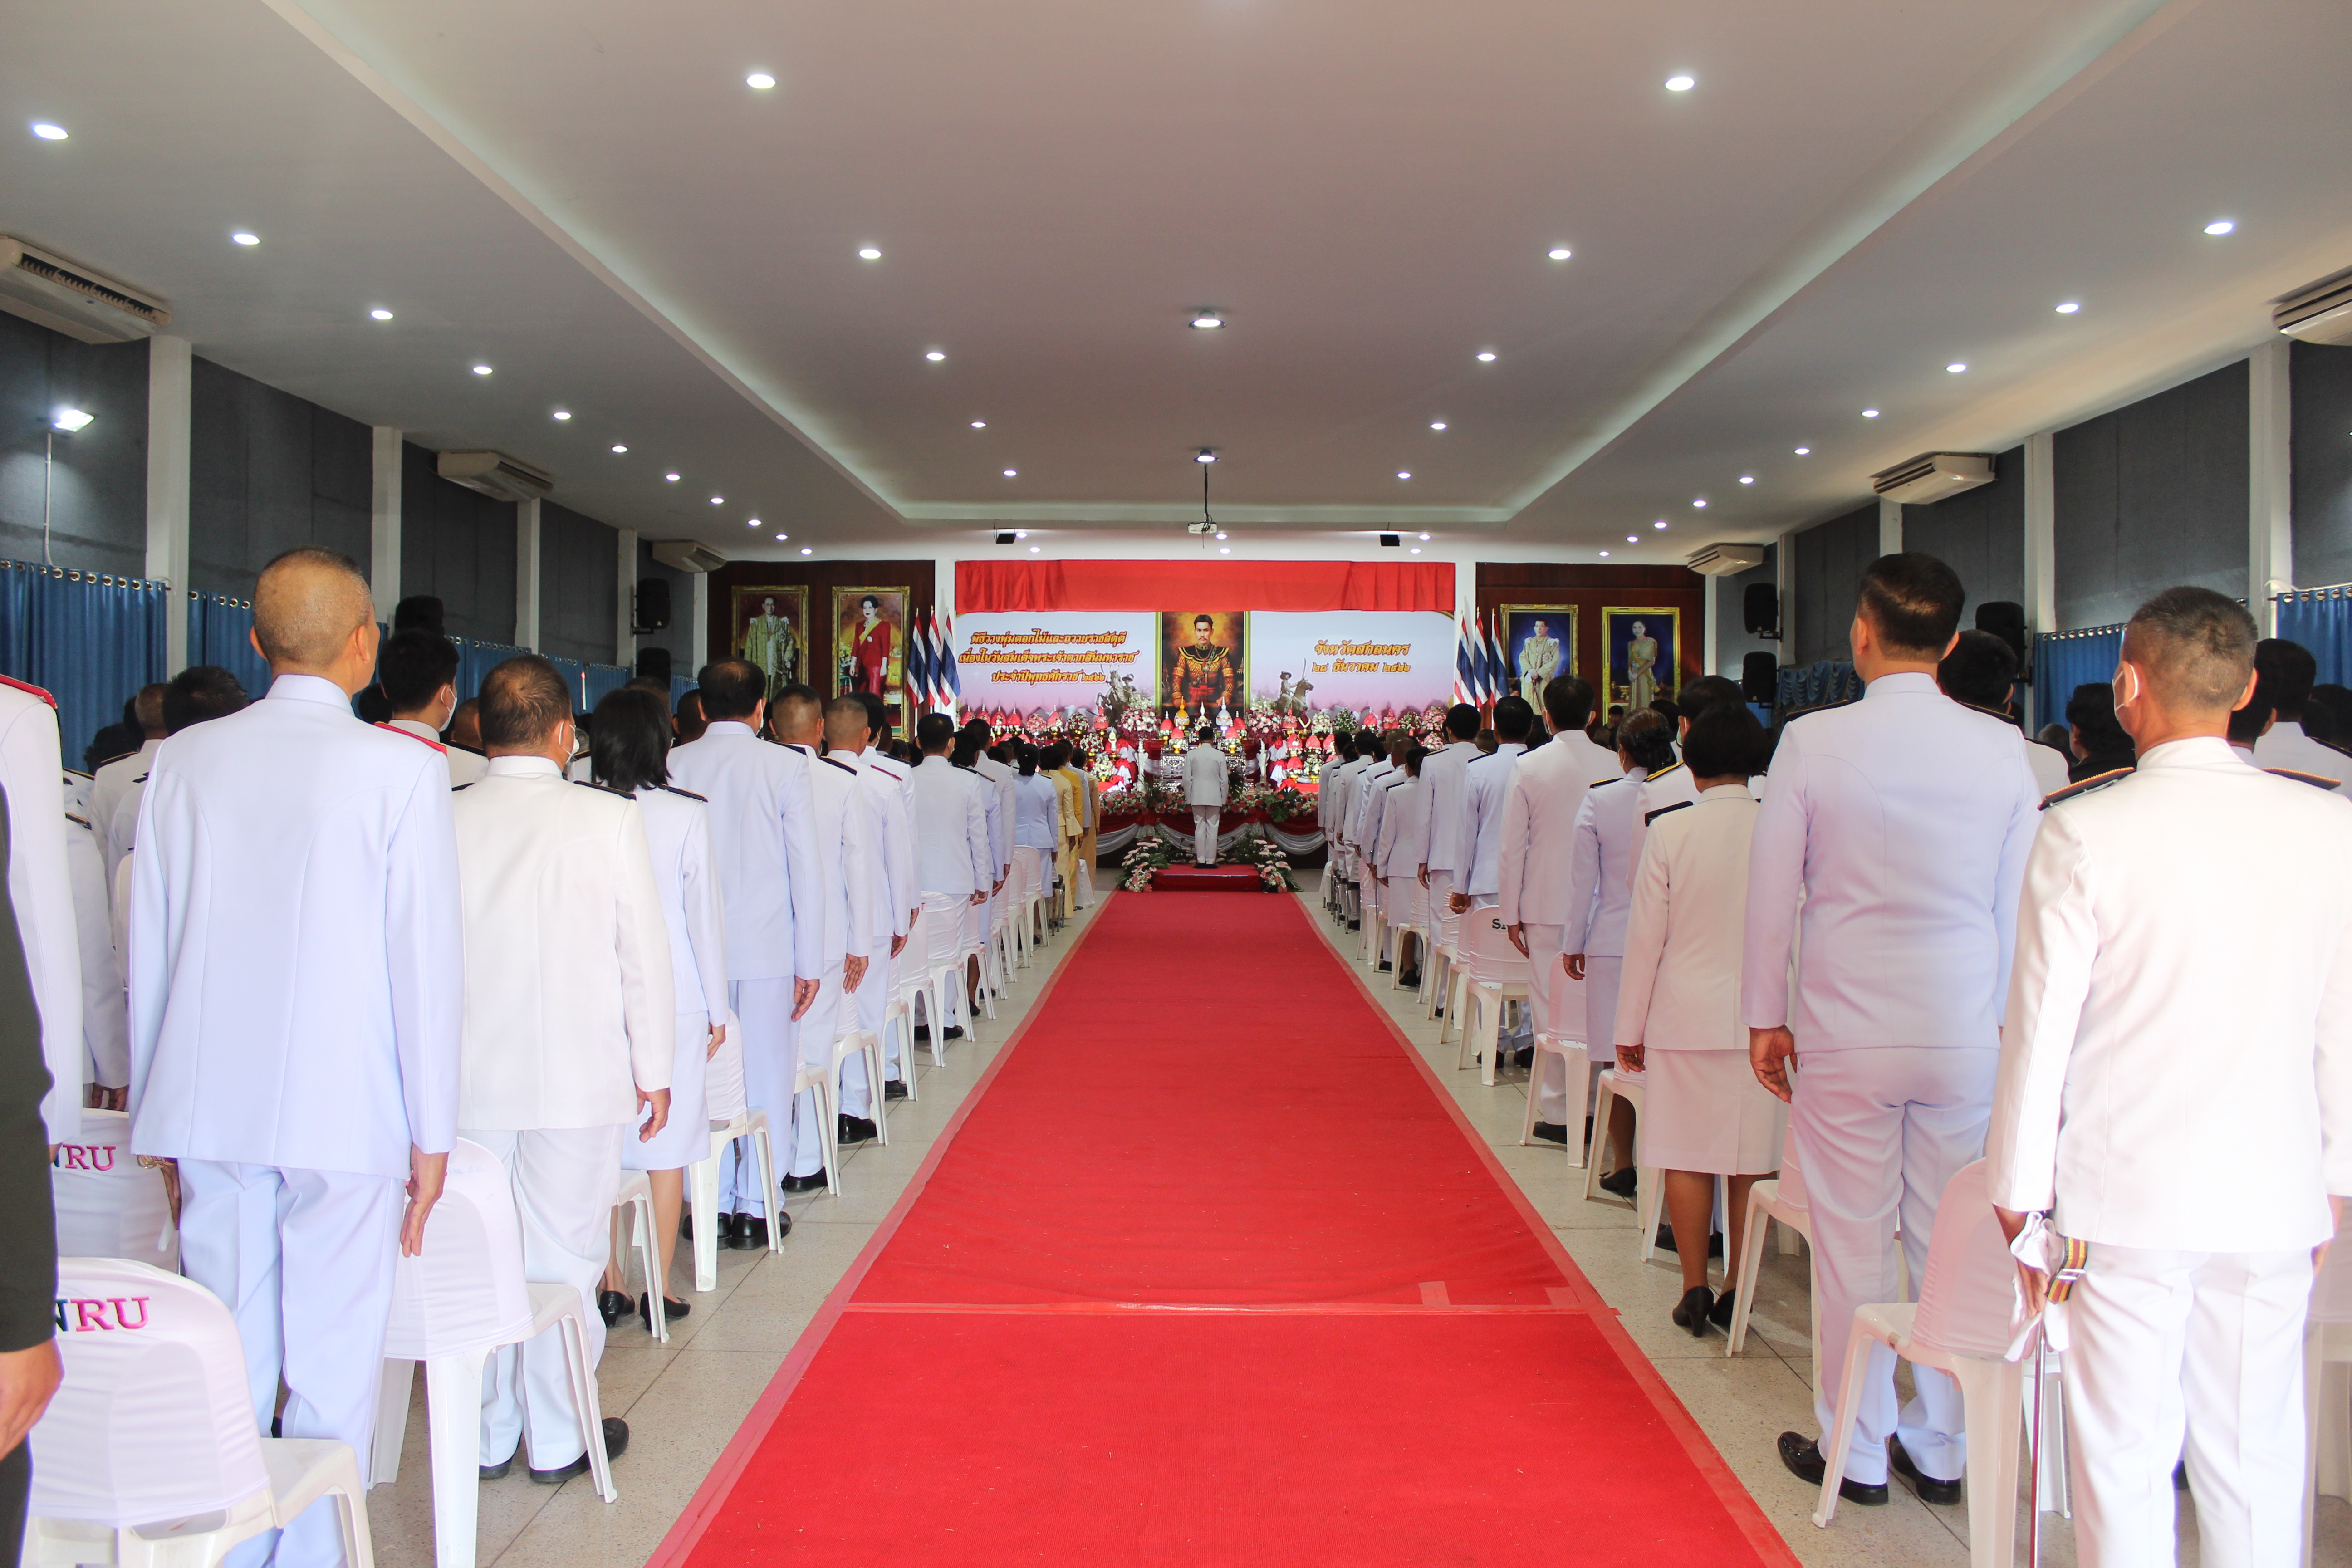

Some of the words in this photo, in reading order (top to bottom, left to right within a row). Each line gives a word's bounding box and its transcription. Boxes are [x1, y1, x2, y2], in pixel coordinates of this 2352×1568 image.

[970, 628, 1127, 647] พิธีวางพุ่มดอกไม้และถวายราชสดุดี
[958, 647, 1140, 663] เนื่องในวันสมเด็จพระเจ้าตากสินมหาราช
[1314, 639, 1411, 656] จังหวัดสกลนคร
[1312, 662, 1329, 672] ๒๘
[1332, 658, 1380, 673] ธันวาคม
[1382, 662, 1411, 672] ๒๕๖๖
[991, 668, 1084, 686] ประจำปีพุทธศักราช
[1081, 672, 1106, 682] ๒๕๖๖
[51, 1144, 117, 1171] RU
